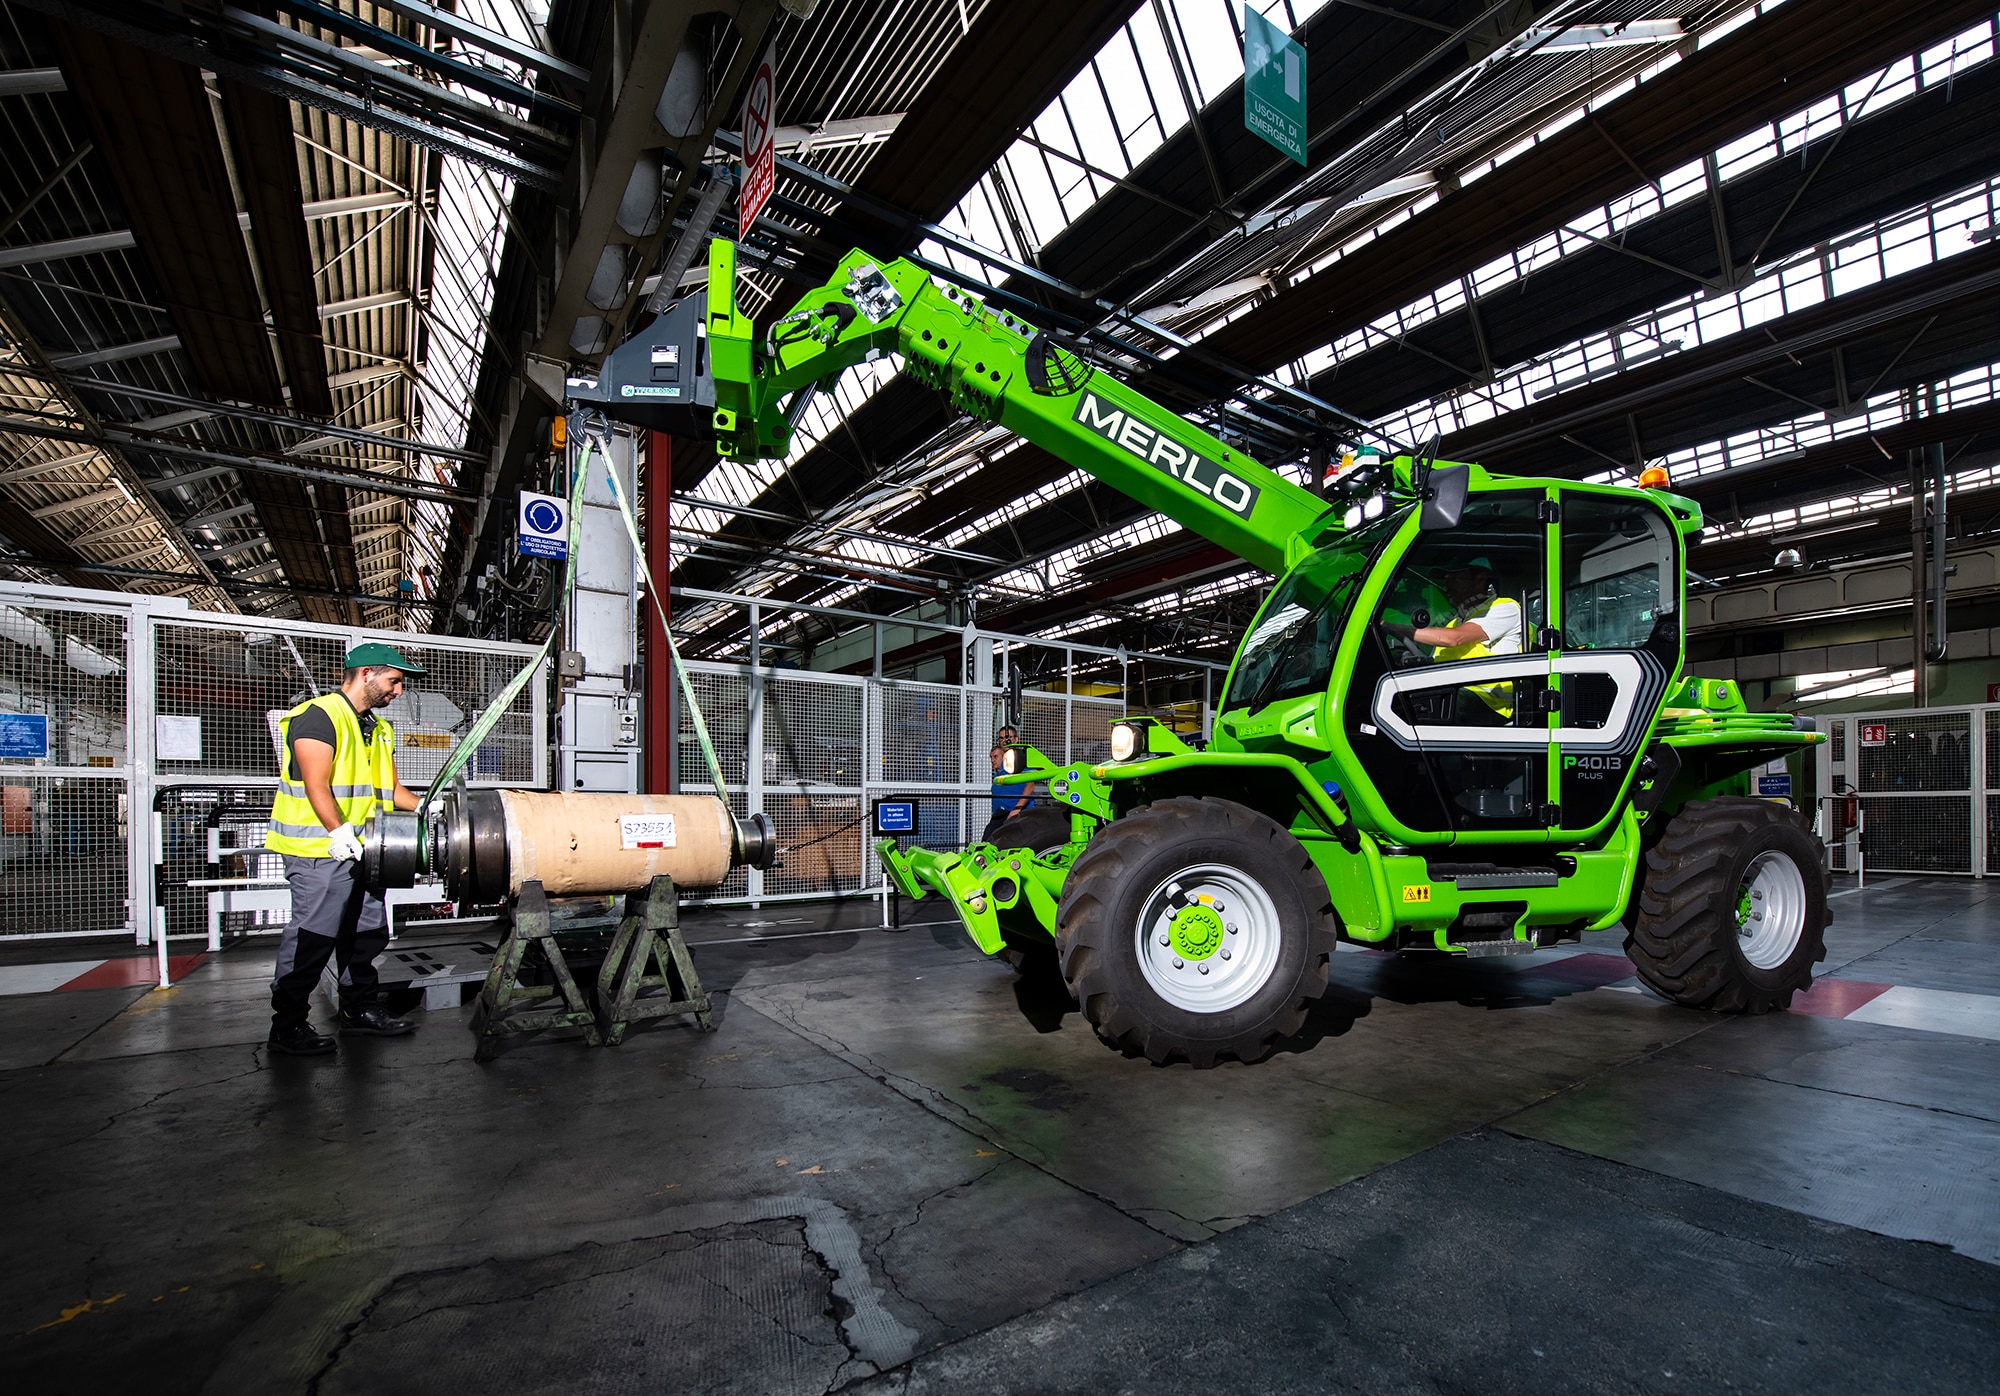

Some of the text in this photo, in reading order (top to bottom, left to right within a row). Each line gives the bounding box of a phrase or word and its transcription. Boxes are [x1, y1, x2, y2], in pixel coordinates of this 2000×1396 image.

[1249, 111, 1302, 156] EMERGENZA
[1255, 100, 1297, 139] USCITA DI
[742, 148, 771, 206] VIETATO
[741, 169, 771, 230] FUMARE
[1078, 393, 1252, 513] MERLO
[530, 537, 562, 547] OBBLIGATORIO
[531, 548, 557, 556] AURICOLARI
[1577, 772, 1604, 780] PLUS
